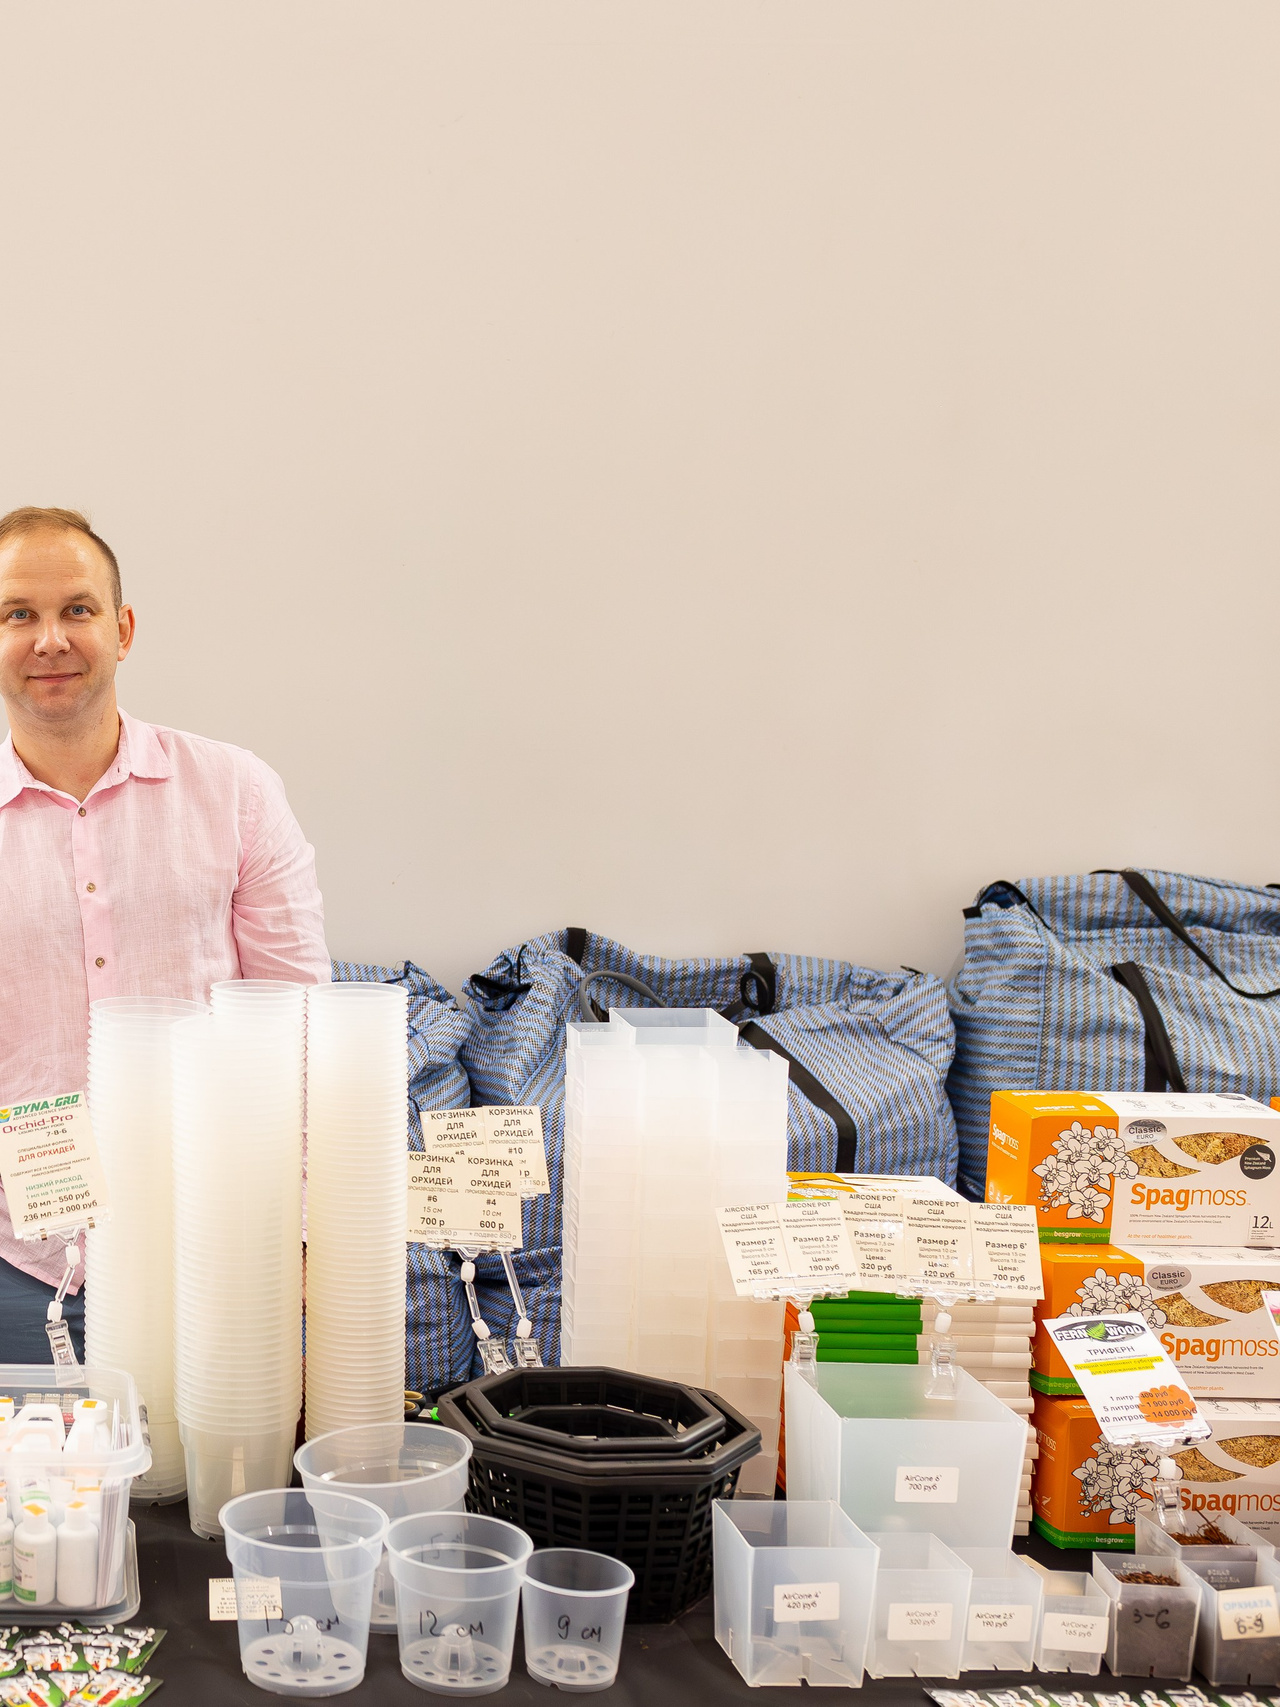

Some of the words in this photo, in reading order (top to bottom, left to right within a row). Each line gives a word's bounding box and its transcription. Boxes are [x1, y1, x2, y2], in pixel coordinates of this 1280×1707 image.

[13, 1094, 80, 1116] DYNA-GRO
[3, 1114, 73, 1133] Orchid-Pro
[46, 1129, 67, 1137] 7-8-6
[992, 1123, 1019, 1151] Spagmoss
[19, 1153, 35, 1163] ДЛЯ
[37, 1145, 76, 1159] ОРХИДЕЙ
[409, 1154, 455, 1163] КОРЗИНКА
[423, 1166, 441, 1174] ДЛЯ
[412, 1176, 452, 1185] ОРХИДЕЙ
[1131, 1183, 1247, 1211] Spagmoss
[24, 1214, 38, 1222] 236
[66, 1204, 81, 1212] 000
[83, 1200, 98, 1210] руб
[420, 1217, 437, 1225] 700
[440, 1219, 445, 1227] р
[986, 1241, 1018, 1249] Размер
[1055, 1328, 1088, 1341] FERN
[1106, 1324, 1143, 1336] WOOD
[1087, 1346, 1135, 1356] ТРИФЕРН
[1161, 1332, 1279, 1362] Spagmoss
[1113, 1414, 1144, 1423] литров
[1182, 1408, 1197, 1416] руб
[924, 1484, 937, 1492] руб
[787, 1601, 801, 1609] 420
[803, 1601, 817, 1610] руб
[975, 1612, 1002, 1620] AirCone
[420, 1610, 445, 1638] 12
[457, 1621, 484, 1637] см
[557, 1614, 570, 1639] 9
[581, 1626, 602, 1642] см
